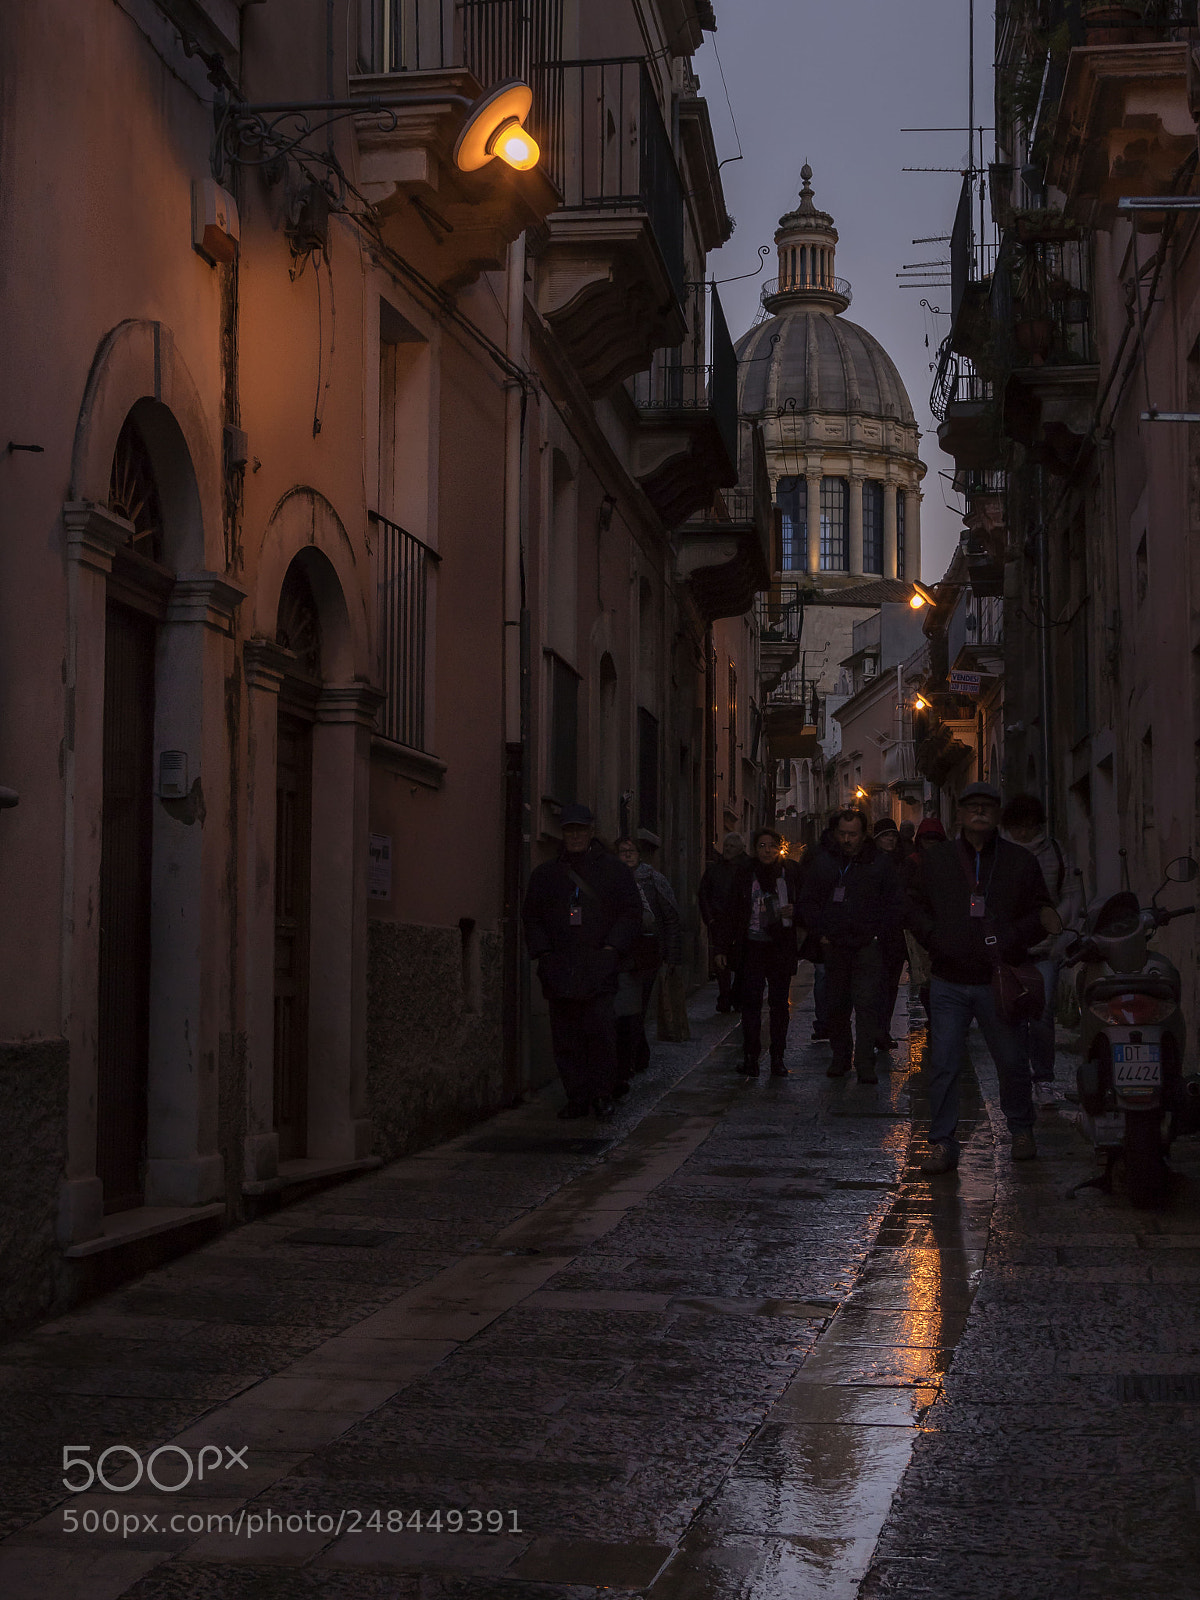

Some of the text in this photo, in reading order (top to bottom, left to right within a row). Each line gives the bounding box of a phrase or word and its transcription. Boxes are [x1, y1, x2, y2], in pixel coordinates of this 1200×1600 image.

[952, 673, 979, 682] VENDESI
[1125, 1046, 1141, 1061] DT
[1118, 1066, 1159, 1081] 44424
